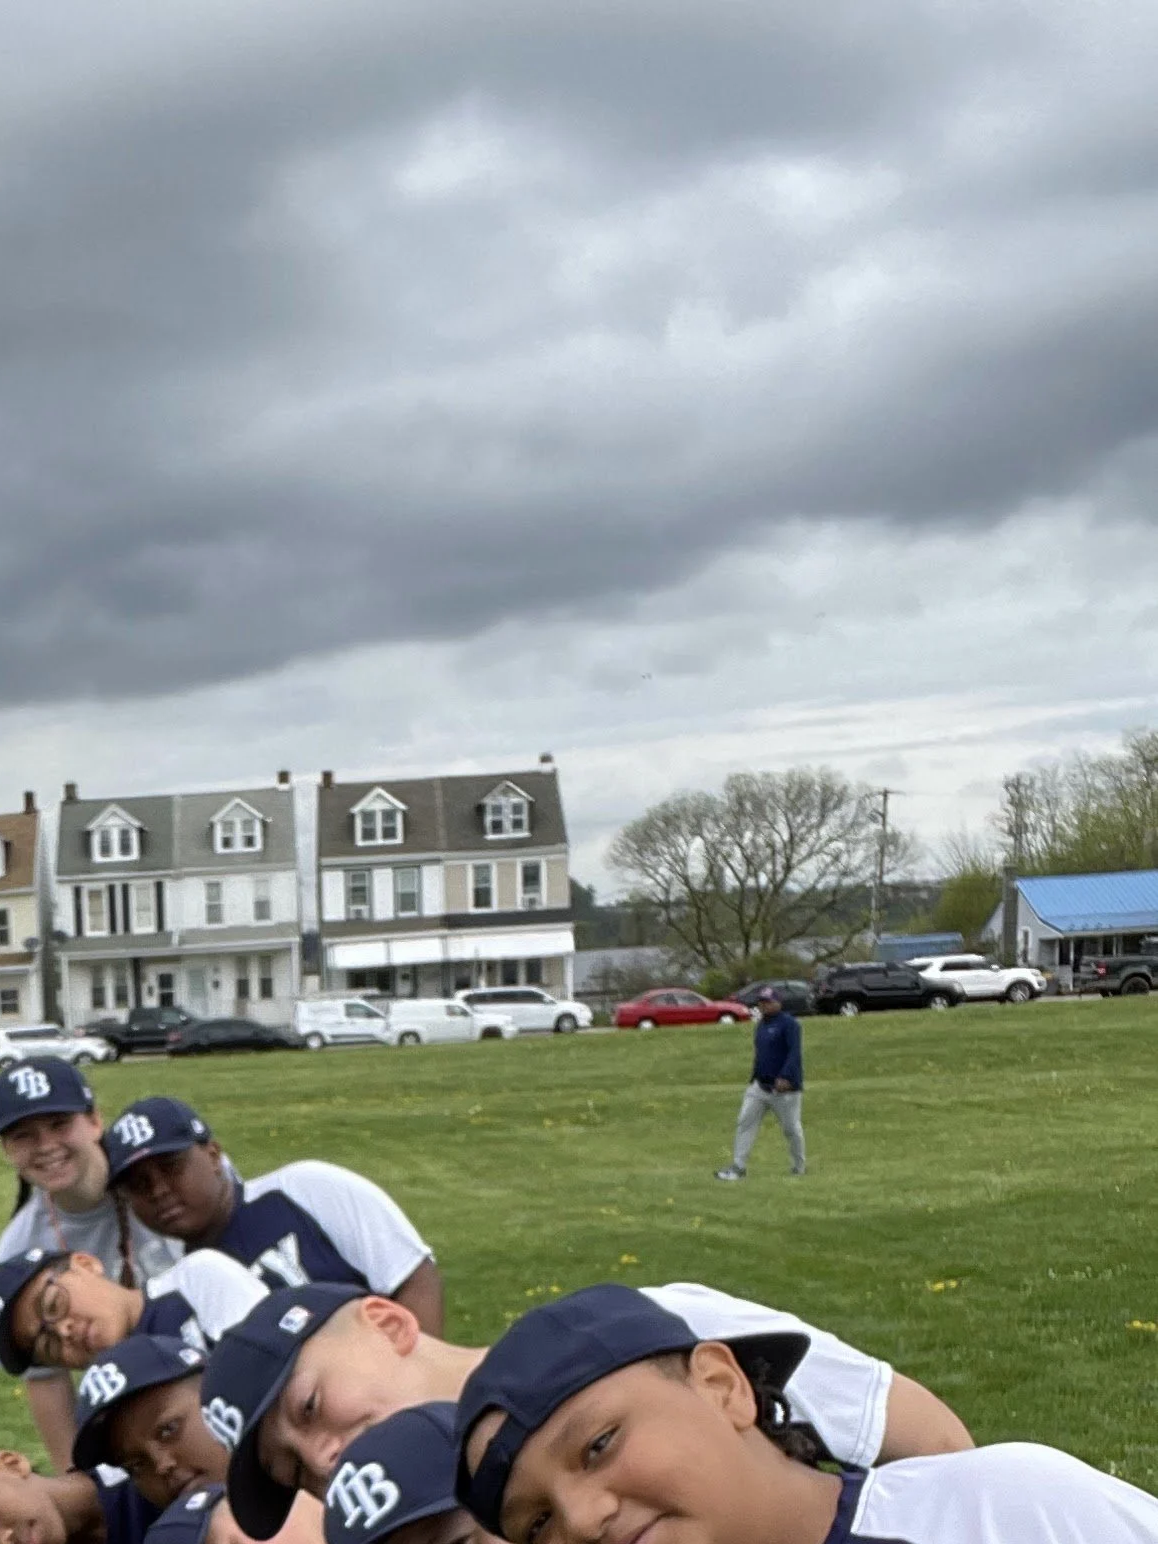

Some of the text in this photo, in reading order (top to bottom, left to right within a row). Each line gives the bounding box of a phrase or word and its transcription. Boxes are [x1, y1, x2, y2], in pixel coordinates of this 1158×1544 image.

[8, 1066, 51, 1100] TB
[113, 1113, 155, 1147] TB
[79, 1362, 128, 1406] TB
[326, 1461, 399, 1529] TB
